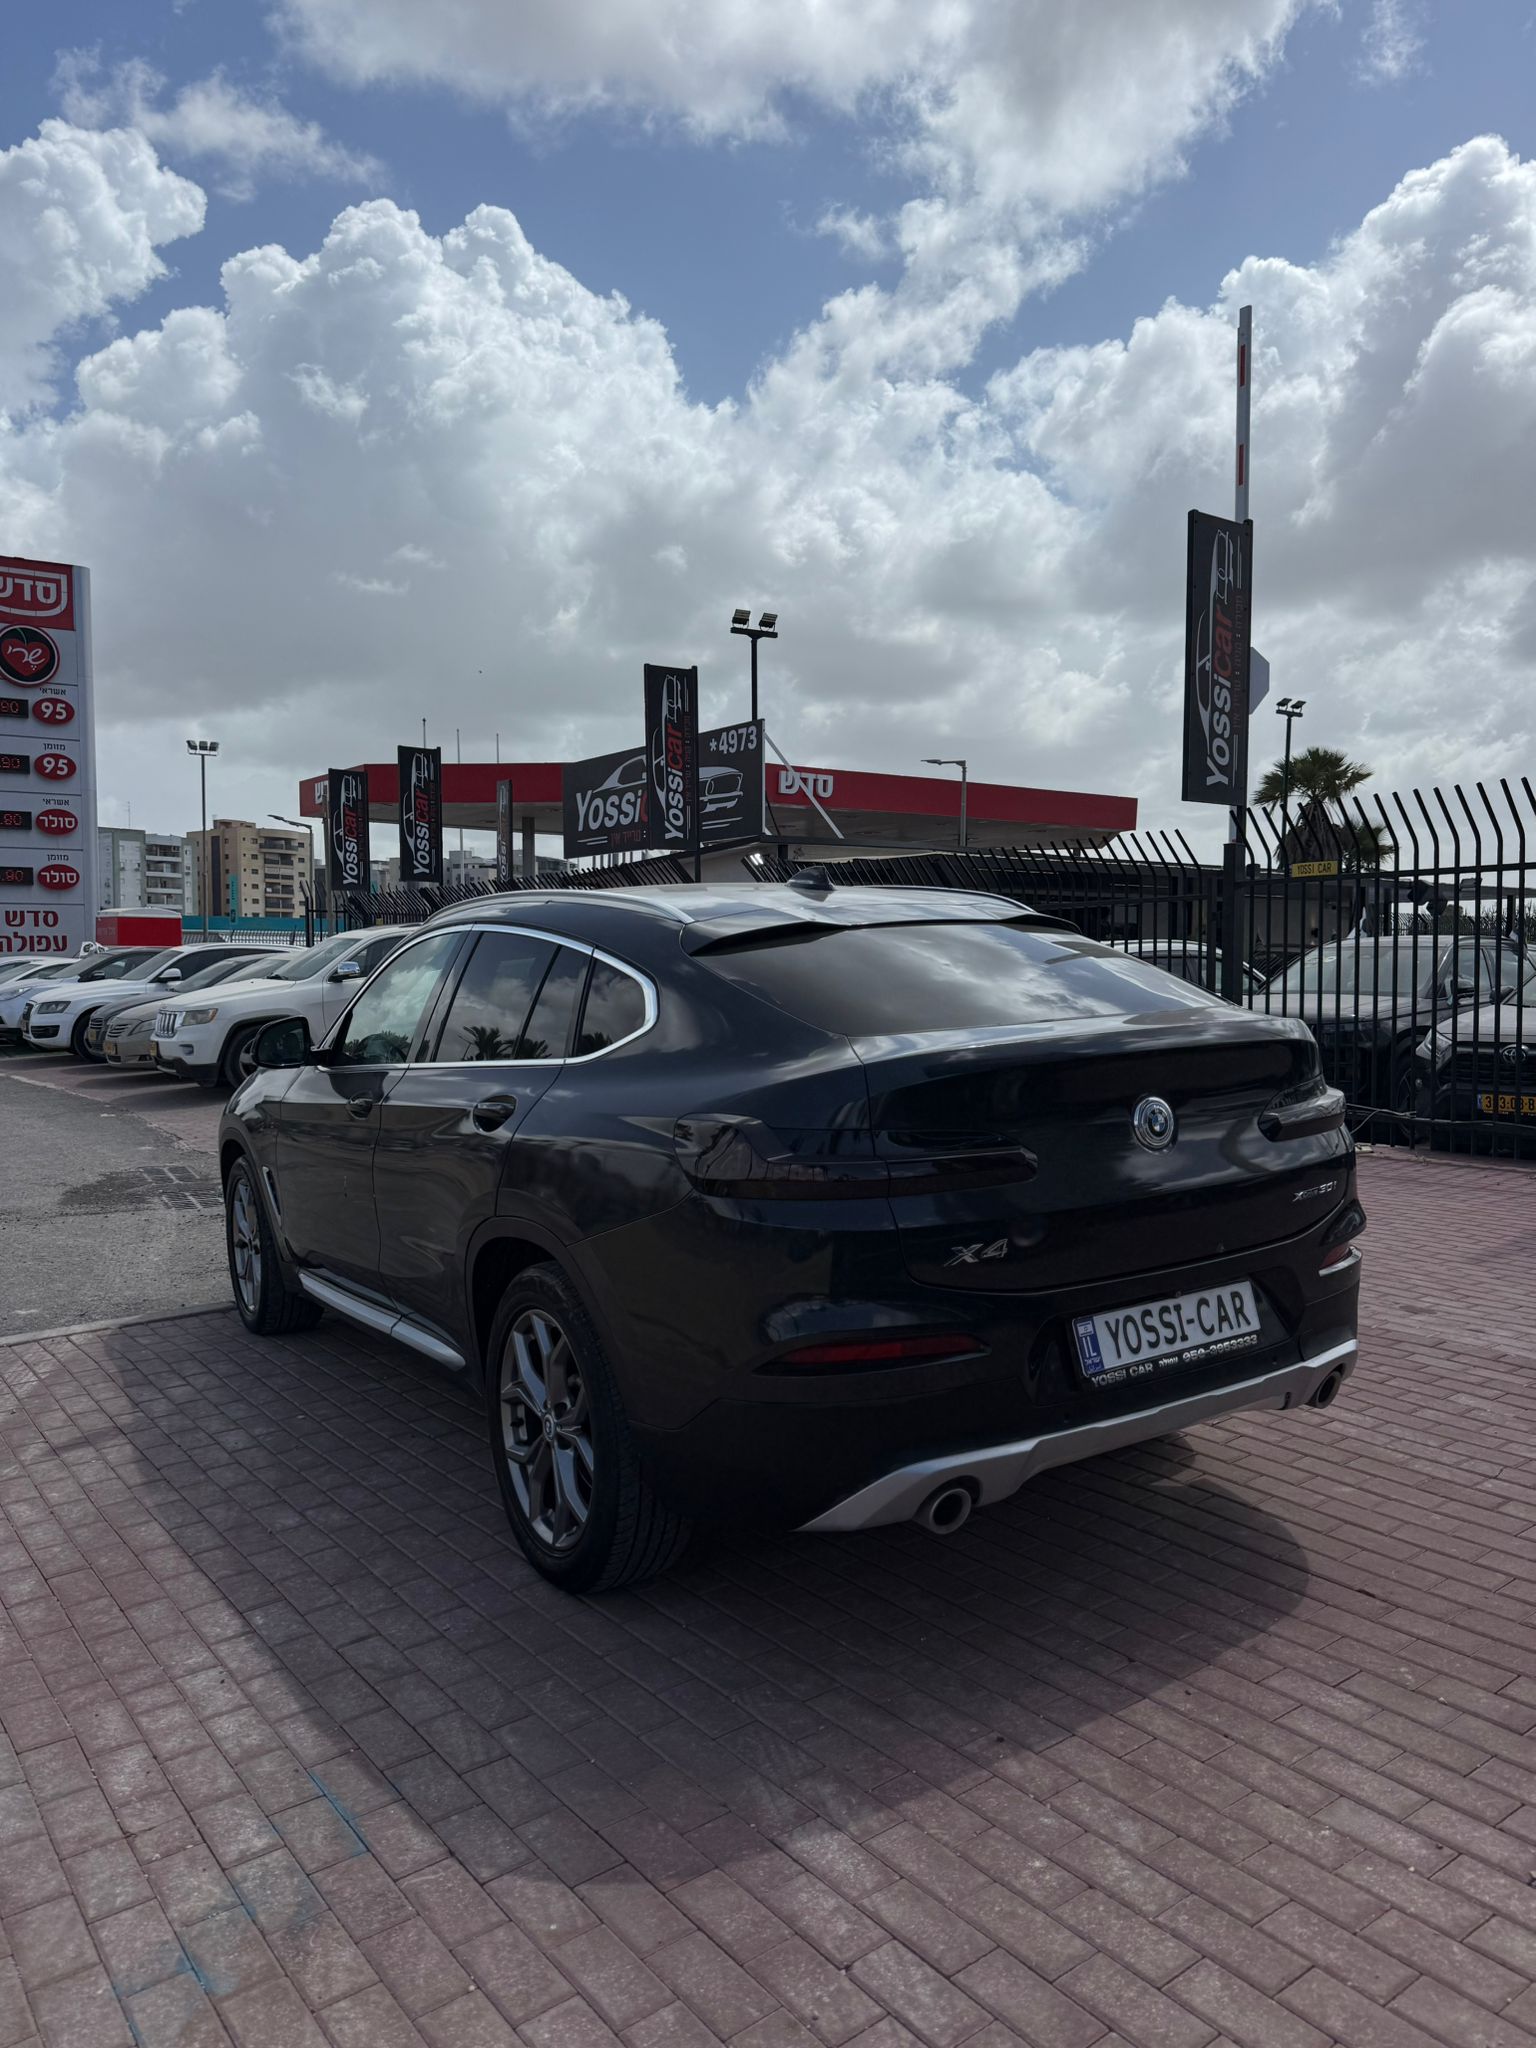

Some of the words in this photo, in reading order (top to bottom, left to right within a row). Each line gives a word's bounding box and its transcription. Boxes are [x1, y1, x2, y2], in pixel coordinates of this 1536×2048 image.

[39, 687, 67, 696] אשראי
[41, 702, 67, 720] 95
[43, 743, 66, 751] מזומן
[43, 757, 68, 776] 95
[778, 770, 834, 798] סדש
[42, 798, 70, 806] אשראי
[40, 815, 75, 829] סולר
[47, 854, 70, 862] מזומן
[41, 870, 77, 884] סולר
[1297, 864, 1315, 875] YOSSI
[1318, 862, 1332, 874] CAR
[5, 910, 59, 928] סדש
[0, 932, 68, 952] עפולה
[944, 1237, 1009, 1268] X4
[1104, 1290, 1252, 1360] YOSSI-CAR
[1082, 1335, 1097, 1358] IL
[1091, 1369, 1127, 1388] YOSSI
[1130, 1362, 1154, 1377] CAR
